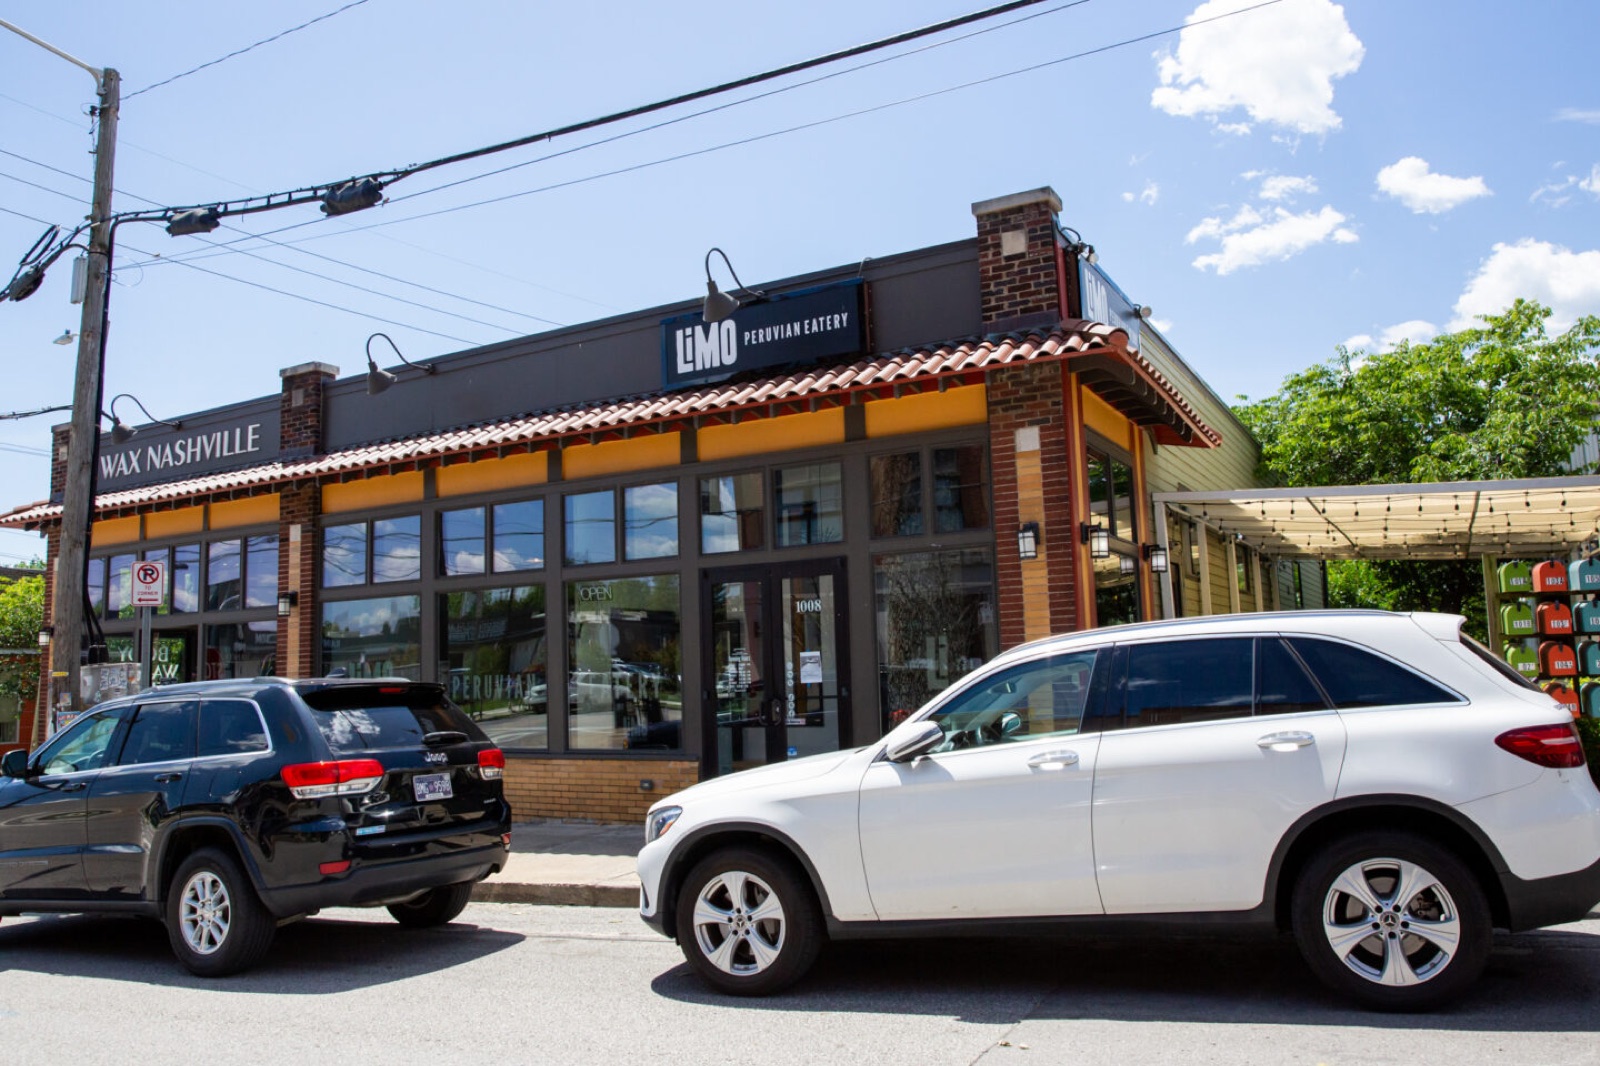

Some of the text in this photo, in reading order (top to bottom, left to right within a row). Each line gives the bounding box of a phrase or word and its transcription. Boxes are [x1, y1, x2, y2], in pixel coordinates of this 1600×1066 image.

[744, 321, 801, 346] PERUVIAN
[803, 312, 849, 335] EATERY
[100, 423, 261, 480] WAX NASHVILLE
[580, 586, 613, 600] OPEN
[796, 599, 822, 613] 1008
[452, 673, 537, 701] PERUVIAN
